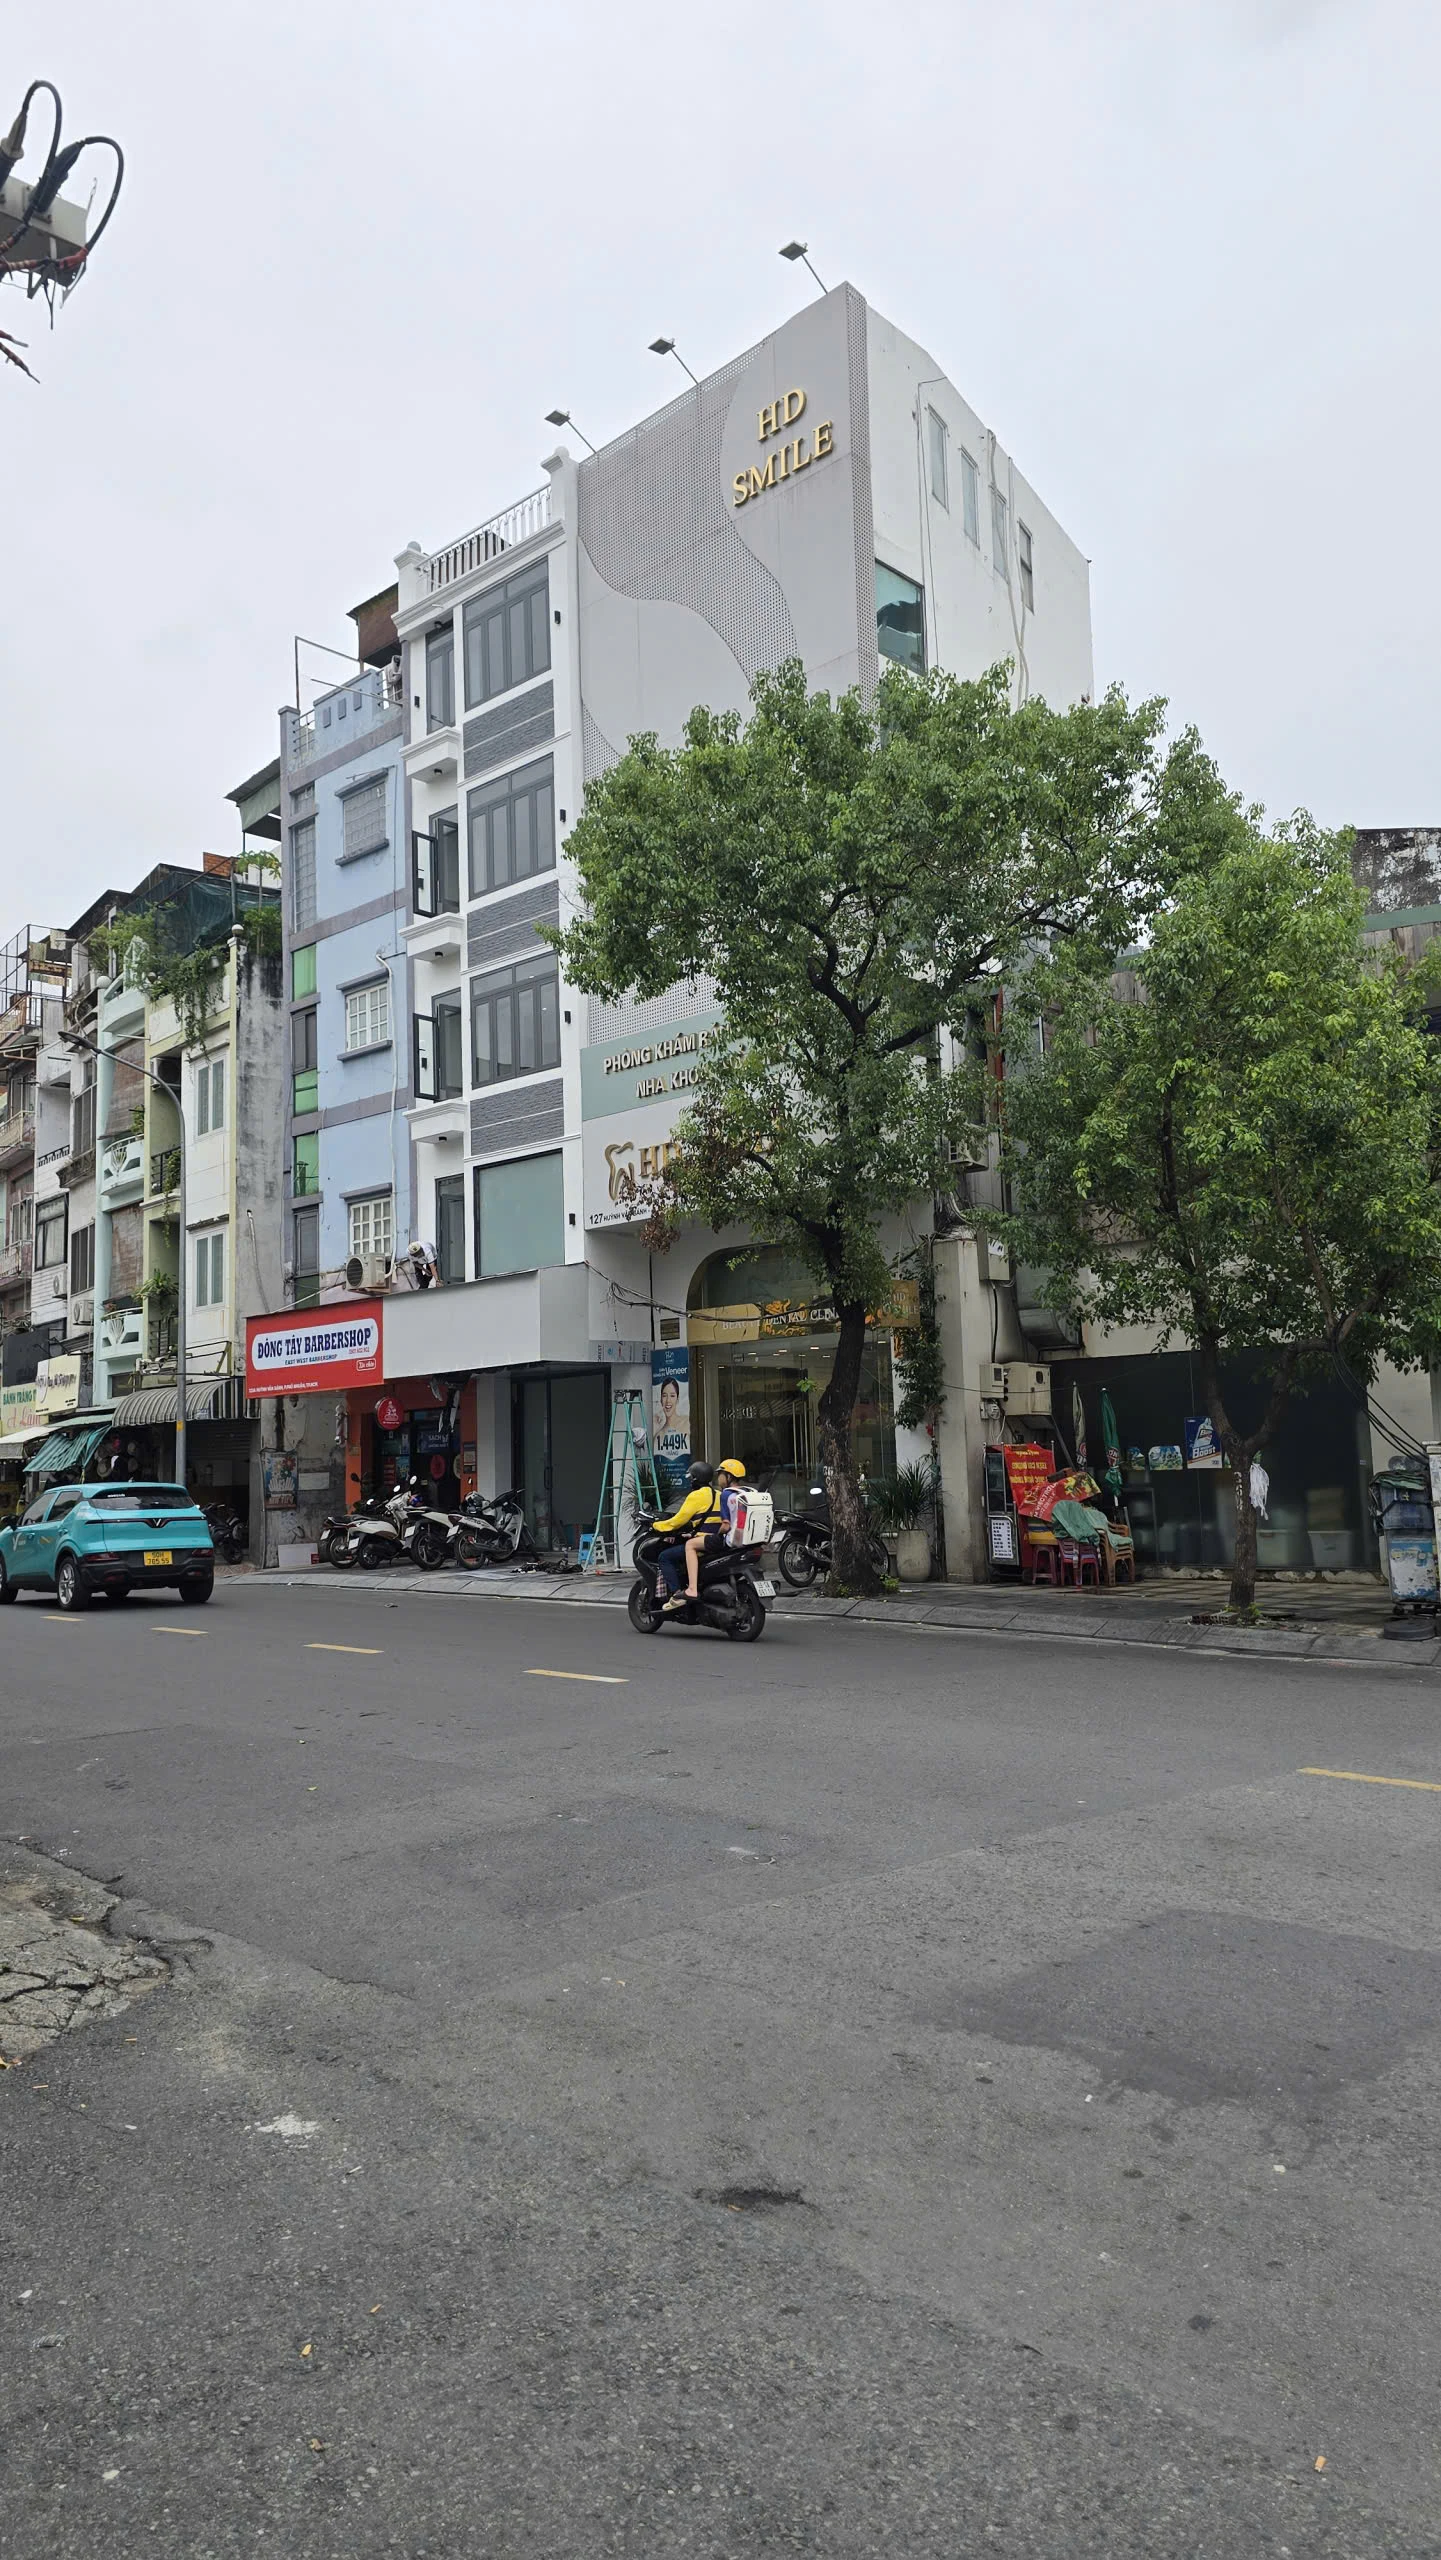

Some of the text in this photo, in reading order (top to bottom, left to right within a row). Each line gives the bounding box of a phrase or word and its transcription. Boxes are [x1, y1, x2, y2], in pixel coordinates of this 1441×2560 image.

[757, 388, 807, 442] HD
[732, 420, 833, 507] SMILE
[655, 1032, 696, 1060] KHÁM
[636, 1067, 700, 1098] NHA KHO
[589, 1213, 604, 1225] 127
[765, 1310, 807, 1326] DENTAL
[257, 1327, 372, 1359] ĐÔNG TÂY BARBERSHOP
[285, 1353, 338, 1366] EAST WEST BARBERSHOP
[665, 1366, 688, 1376] Veneer
[656, 1433, 688, 1451] 1.449K
